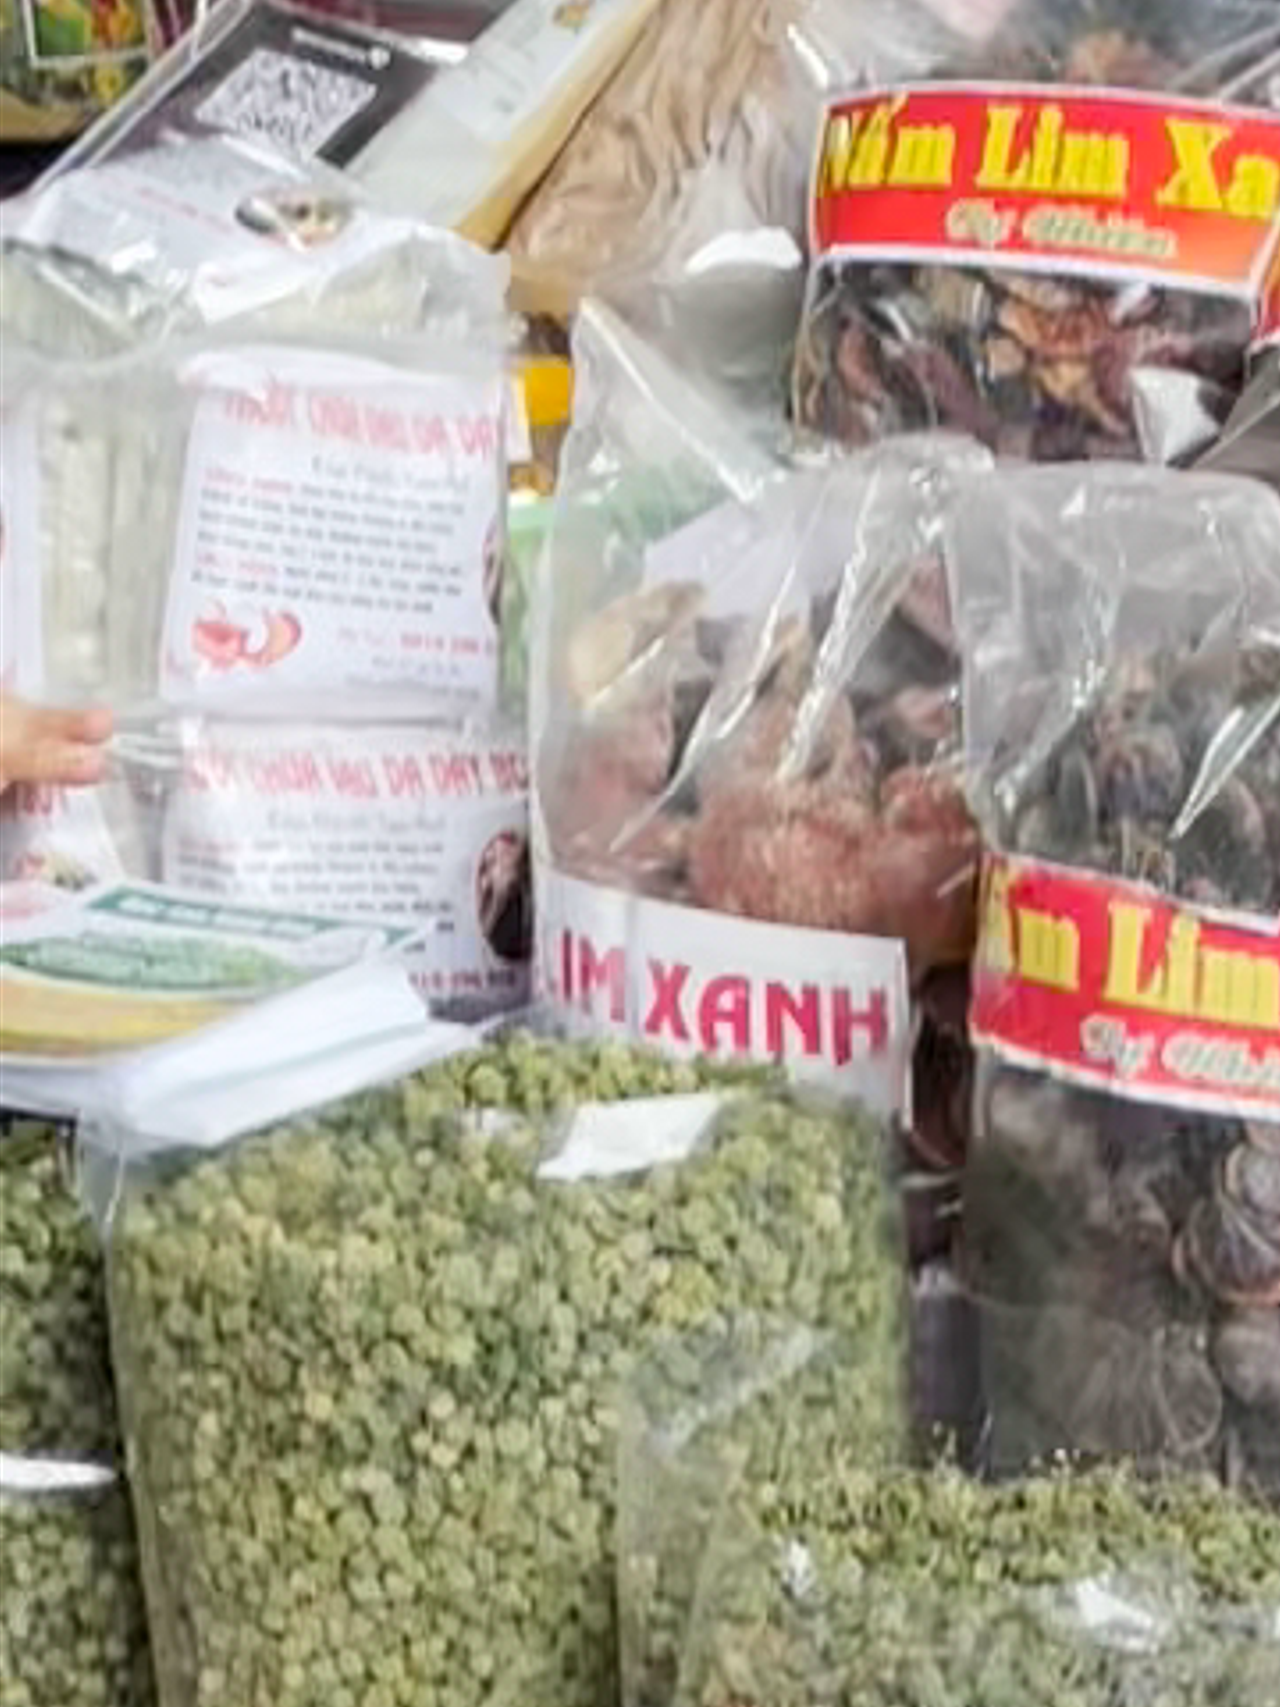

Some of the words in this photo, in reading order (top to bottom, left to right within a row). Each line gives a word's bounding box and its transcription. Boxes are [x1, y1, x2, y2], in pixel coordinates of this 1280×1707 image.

[975, 102, 1130, 199] Lim
[546, 925, 627, 1025] IM
[644, 955, 891, 1069] XANH
